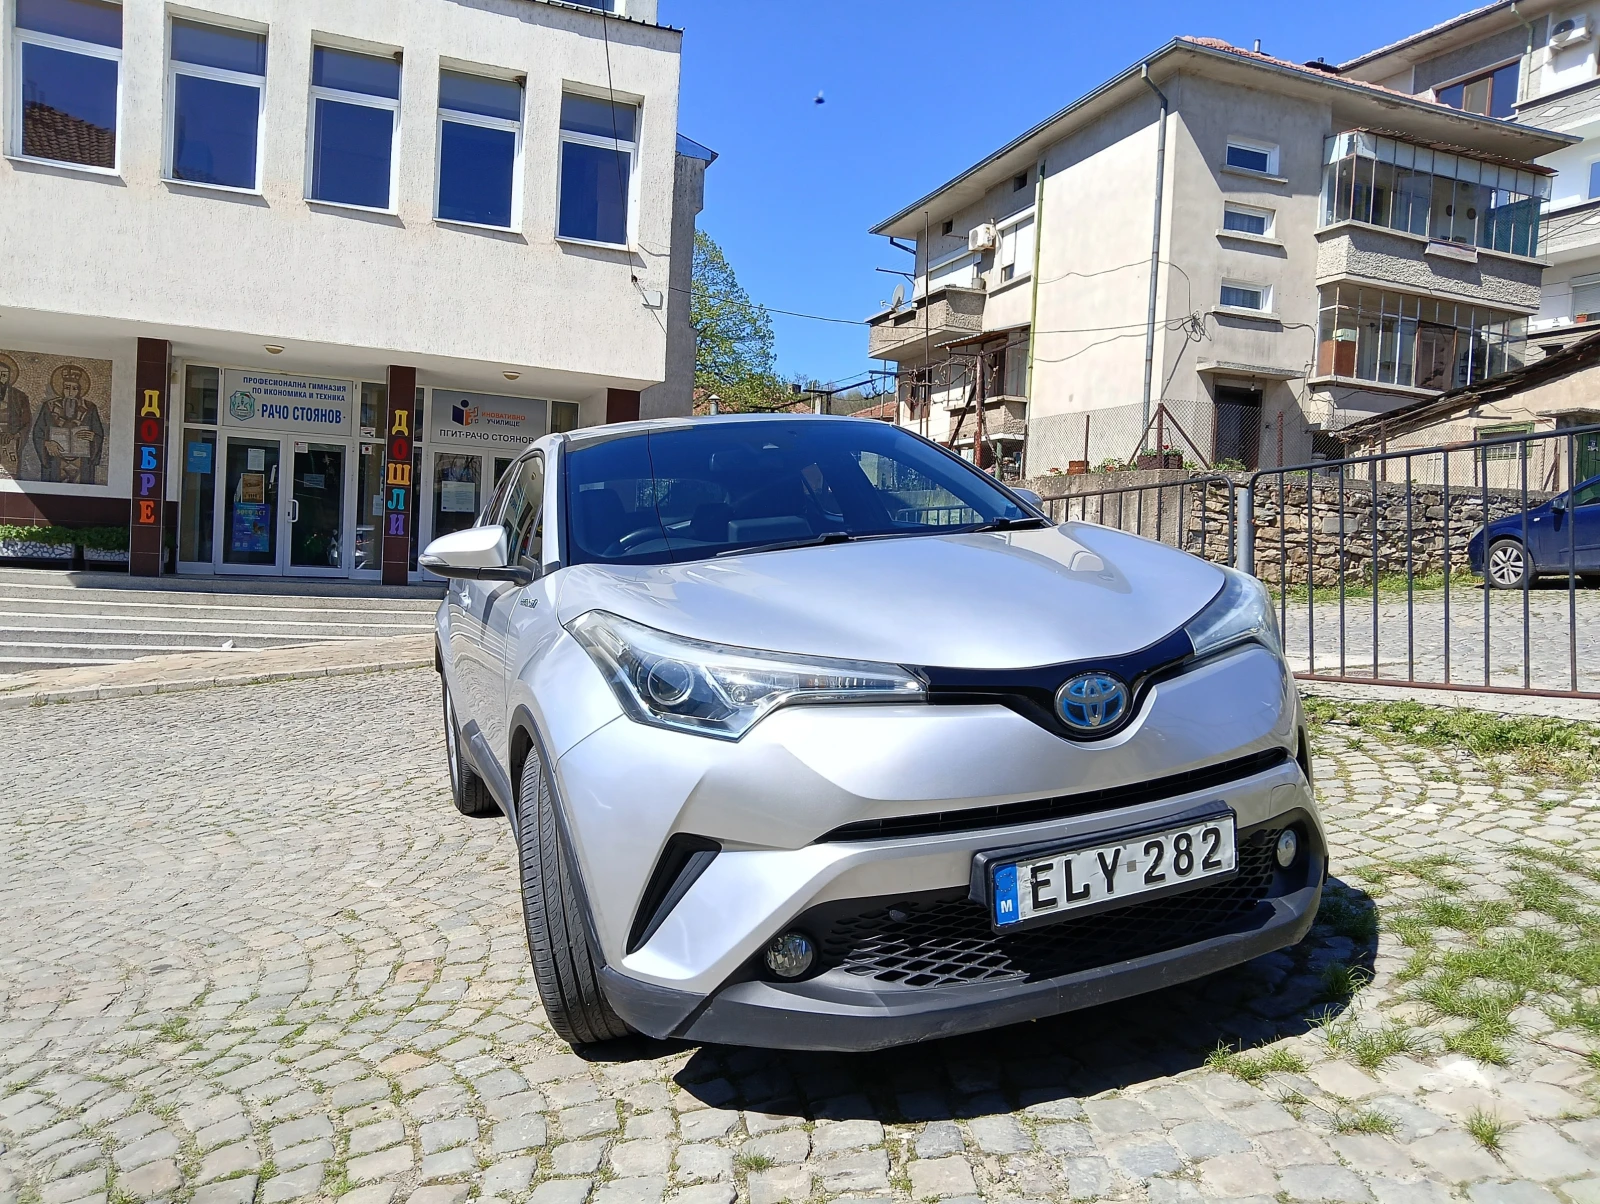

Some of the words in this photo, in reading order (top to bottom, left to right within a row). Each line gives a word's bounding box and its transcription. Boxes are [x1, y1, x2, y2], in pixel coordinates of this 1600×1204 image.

[243, 376, 307, 389] ПРОФЕСИОНАЛНА
[308, 382, 346, 393] ГИМНАЗИЯ
[252, 387, 262, 395] ПО
[264, 388, 307, 399] ИКОНОМИКА
[316, 392, 345, 402] ТЕХНИКА
[261, 403, 289, 420] РАЧО
[292, 406, 342, 424] СТОЯНОВ
[481, 411, 526, 421] ИНОВАТИВНО
[486, 418, 521, 428] УЧИЛИЩЕ
[491, 433, 534, 445] СТОЯНОВ
[139, 389, 161, 524] ДОБРЕ
[387, 409, 411, 536] ДОШЛИ
[1029, 848, 1122, 912] ELY
[1143, 826, 1222, 886] 282
[1000, 899, 1013, 914] M
